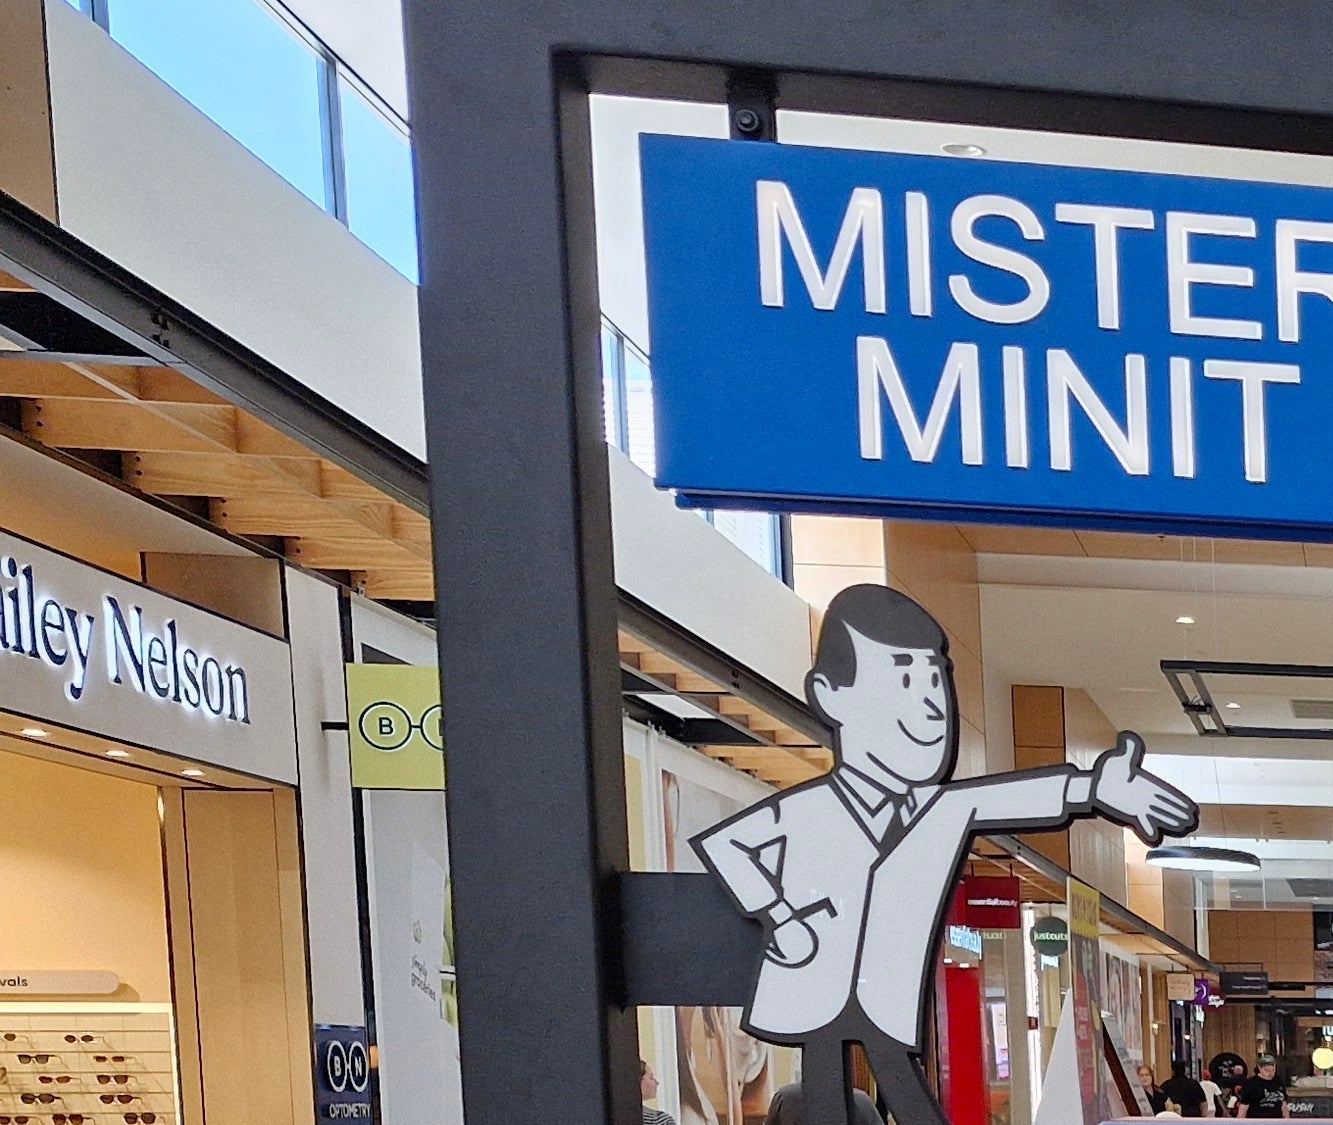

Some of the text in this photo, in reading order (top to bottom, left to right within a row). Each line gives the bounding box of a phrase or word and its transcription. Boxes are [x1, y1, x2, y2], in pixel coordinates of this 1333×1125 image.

[856, 335, 1300, 484] MINIT
[0, 557, 250, 725] iley Nelson
[329, 1103, 371, 1119] OPTOMETRY
